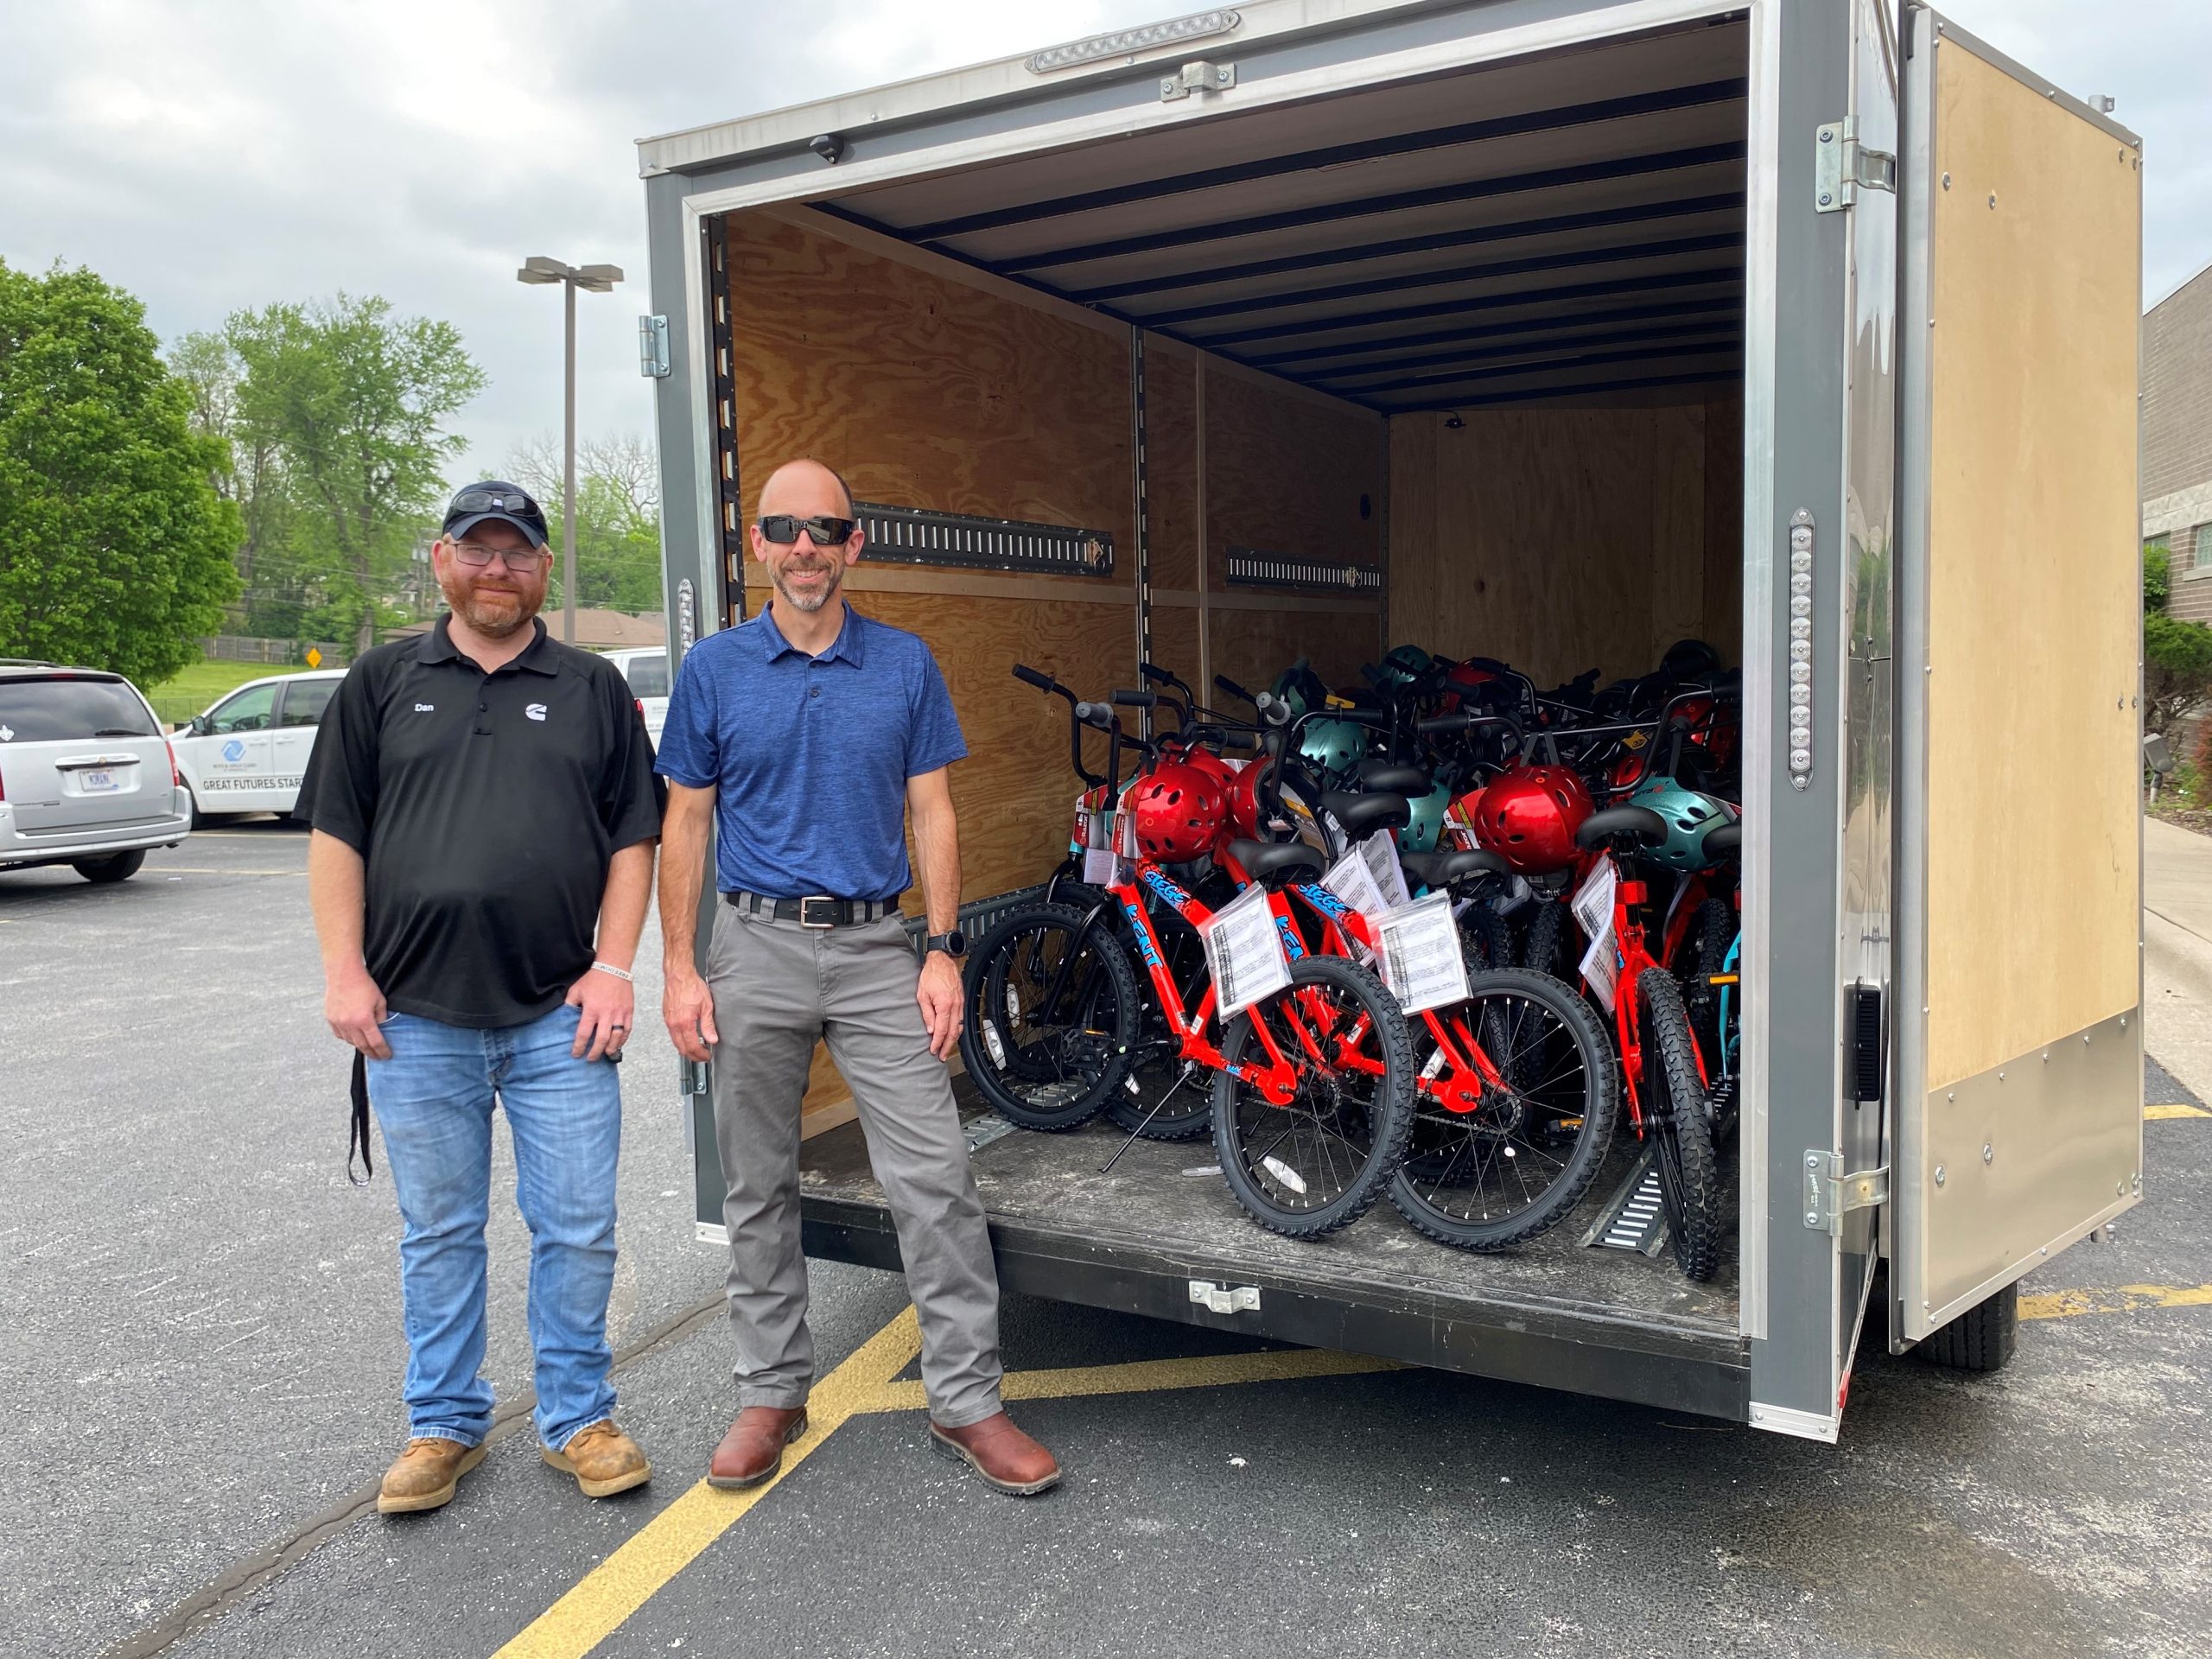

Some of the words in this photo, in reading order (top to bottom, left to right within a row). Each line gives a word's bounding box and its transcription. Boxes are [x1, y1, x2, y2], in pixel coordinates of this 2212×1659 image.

[415, 703, 434, 712] Dan
[203, 780, 232, 791] GREAT
[234, 779, 276, 790] FUTURES
[277, 778, 304, 788] STAR
[1126, 904, 1164, 968] KENT
[1274, 916, 1304, 960] KEN
